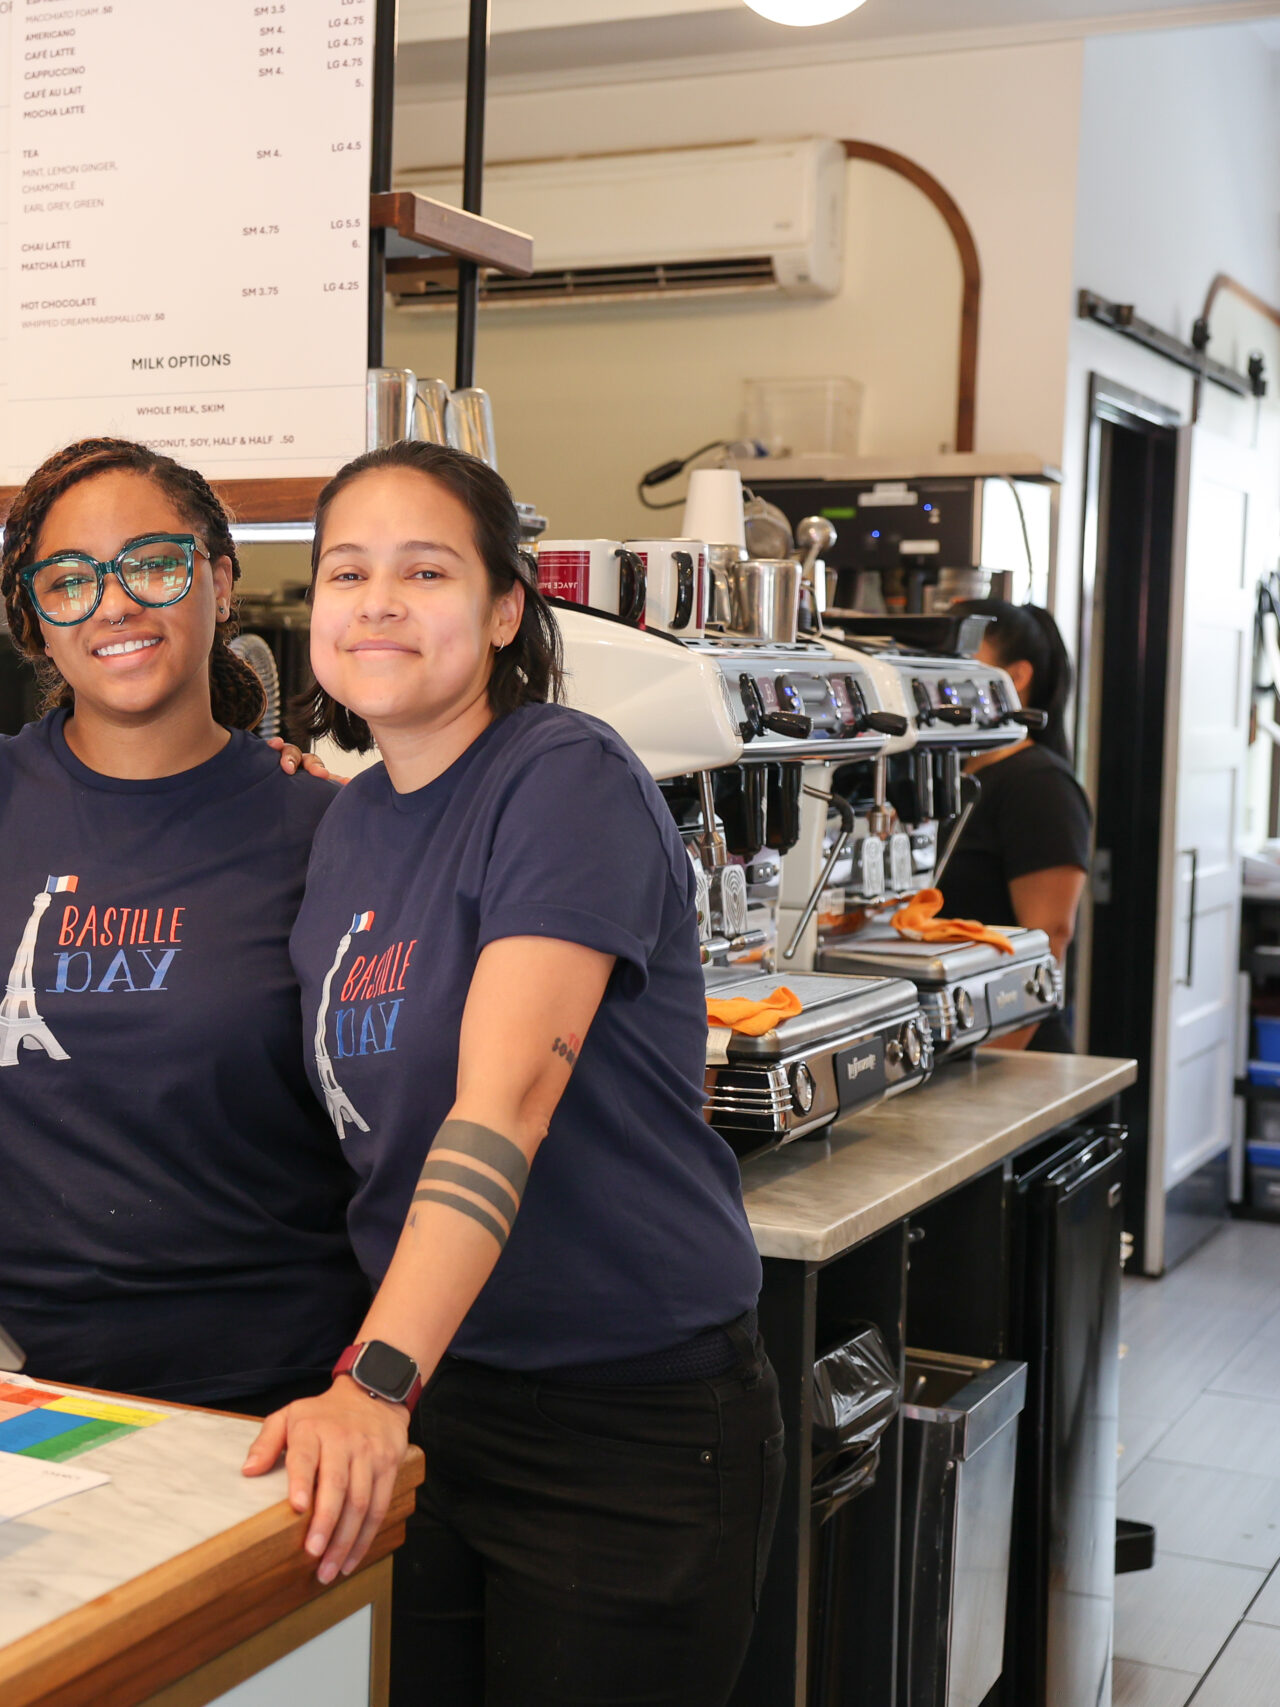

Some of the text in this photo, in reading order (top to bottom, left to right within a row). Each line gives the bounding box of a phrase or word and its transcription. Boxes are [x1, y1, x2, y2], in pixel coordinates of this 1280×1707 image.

[254, 7, 269, 16] SM
[328, 16, 365, 28] LG 4.75
[25, 29, 76, 41] AMERICANO
[260, 27, 274, 36] SM
[328, 37, 364, 49] LG 4.75
[49, 47, 76, 58] LATTE
[259, 48, 273, 57] SM
[327, 58, 363, 70] LG 4.75
[24, 66, 86, 80] CAPPUCCINO
[259, 68, 273, 77] SM
[49, 88, 61, 97] AU
[63, 86, 82, 96] LAIT
[23, 105, 86, 119] MOCHA LATTE
[332, 141, 362, 152] LG 4.5
[22, 149, 39, 158] TEA
[257, 151, 271, 159] SM
[47, 165, 79, 176] LEMON
[24, 199, 105, 214] EARL GREEN
[331, 219, 361, 229] LG 5.5
[243, 225, 279, 236] SM 4.75
[21, 240, 72, 252] CHAI LATTE
[21, 259, 87, 271] MATCHA LATTE
[242, 288, 256, 297] SM
[323, 282, 359, 292] LG 4.25
[21, 297, 97, 311] HOT CHOCOLATE
[132, 354, 231, 370] MILK OPTIONS
[137, 406, 171, 415] WHOLE
[201, 404, 225, 413] SKIM
[213, 437, 237, 446] HALF
[249, 436, 273, 445] HALF
[58, 905, 186, 947] BASTILLE
[46, 948, 183, 993] DAY
[333, 998, 405, 1059] DAY
